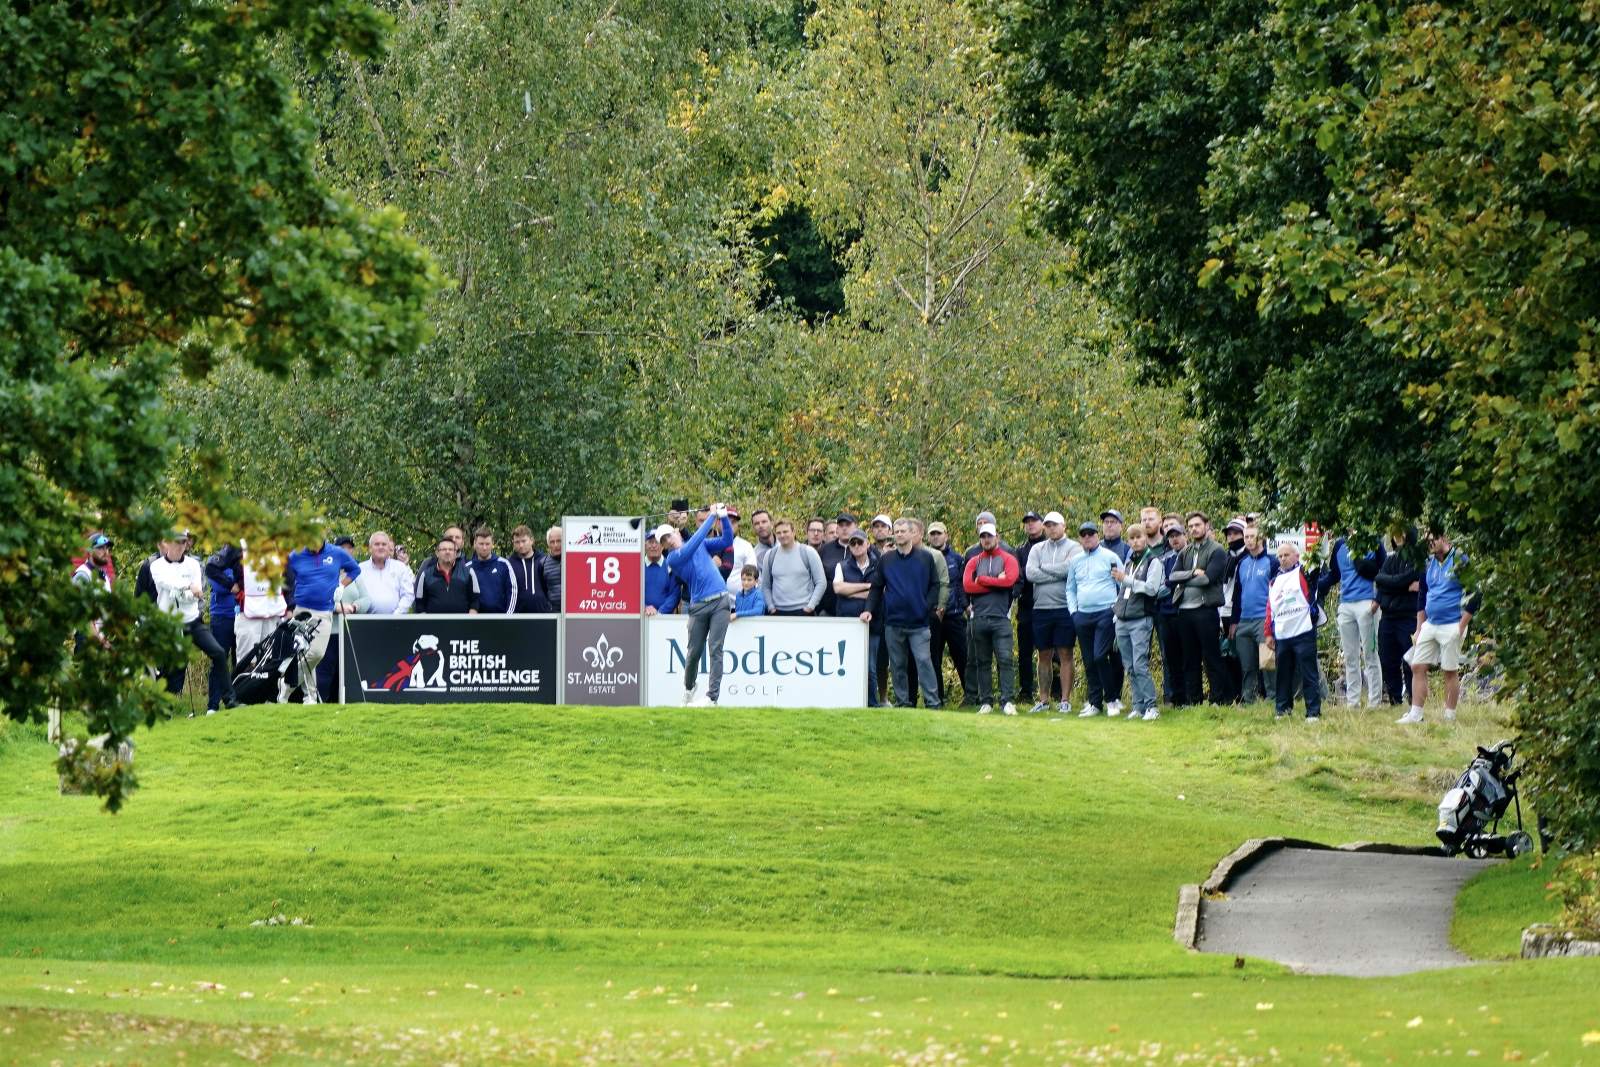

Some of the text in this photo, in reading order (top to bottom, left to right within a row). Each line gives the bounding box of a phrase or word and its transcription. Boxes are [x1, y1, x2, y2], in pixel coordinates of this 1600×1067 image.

[586, 556, 620, 584] 18
[591, 589, 614, 598] Par 4
[579, 600, 627, 612] 470 yards
[450, 640, 479, 653] THE
[450, 655, 506, 669] BRITISH
[450, 670, 540, 684] CHALLENGE
[567, 672, 638, 684] ST. MELLION
[588, 685, 616, 694] ESTATE
[728, 685, 784, 696] GOLF
